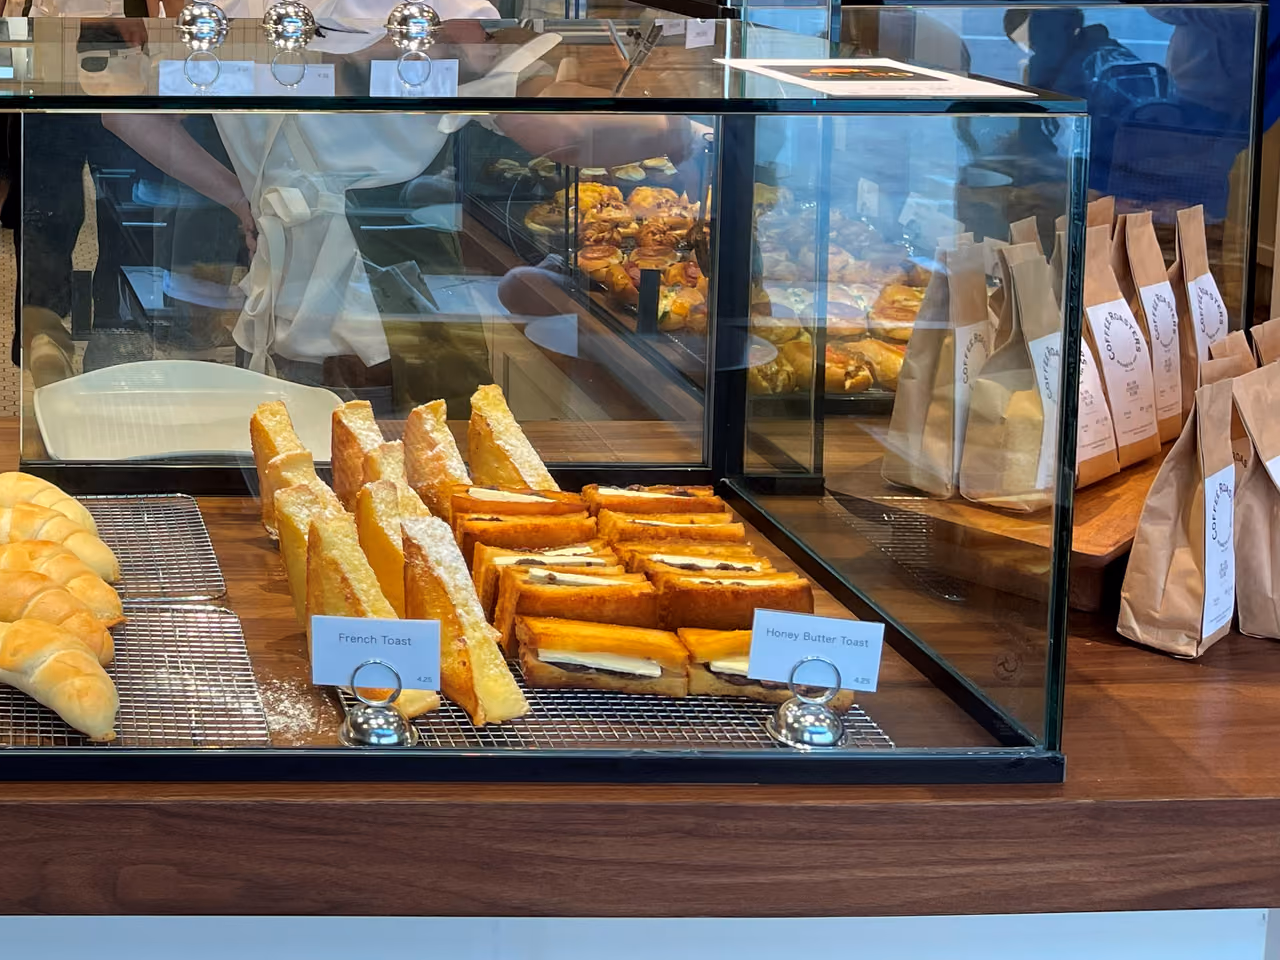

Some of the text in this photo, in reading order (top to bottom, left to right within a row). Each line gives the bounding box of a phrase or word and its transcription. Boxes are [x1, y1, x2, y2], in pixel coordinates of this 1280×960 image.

[1103, 317, 1116, 360] COFFEE
[1108, 311, 1142, 353] ROASTERS
[338, 633, 412, 646] French Toast
[766, 627, 869, 648] Honey Butter Toast
